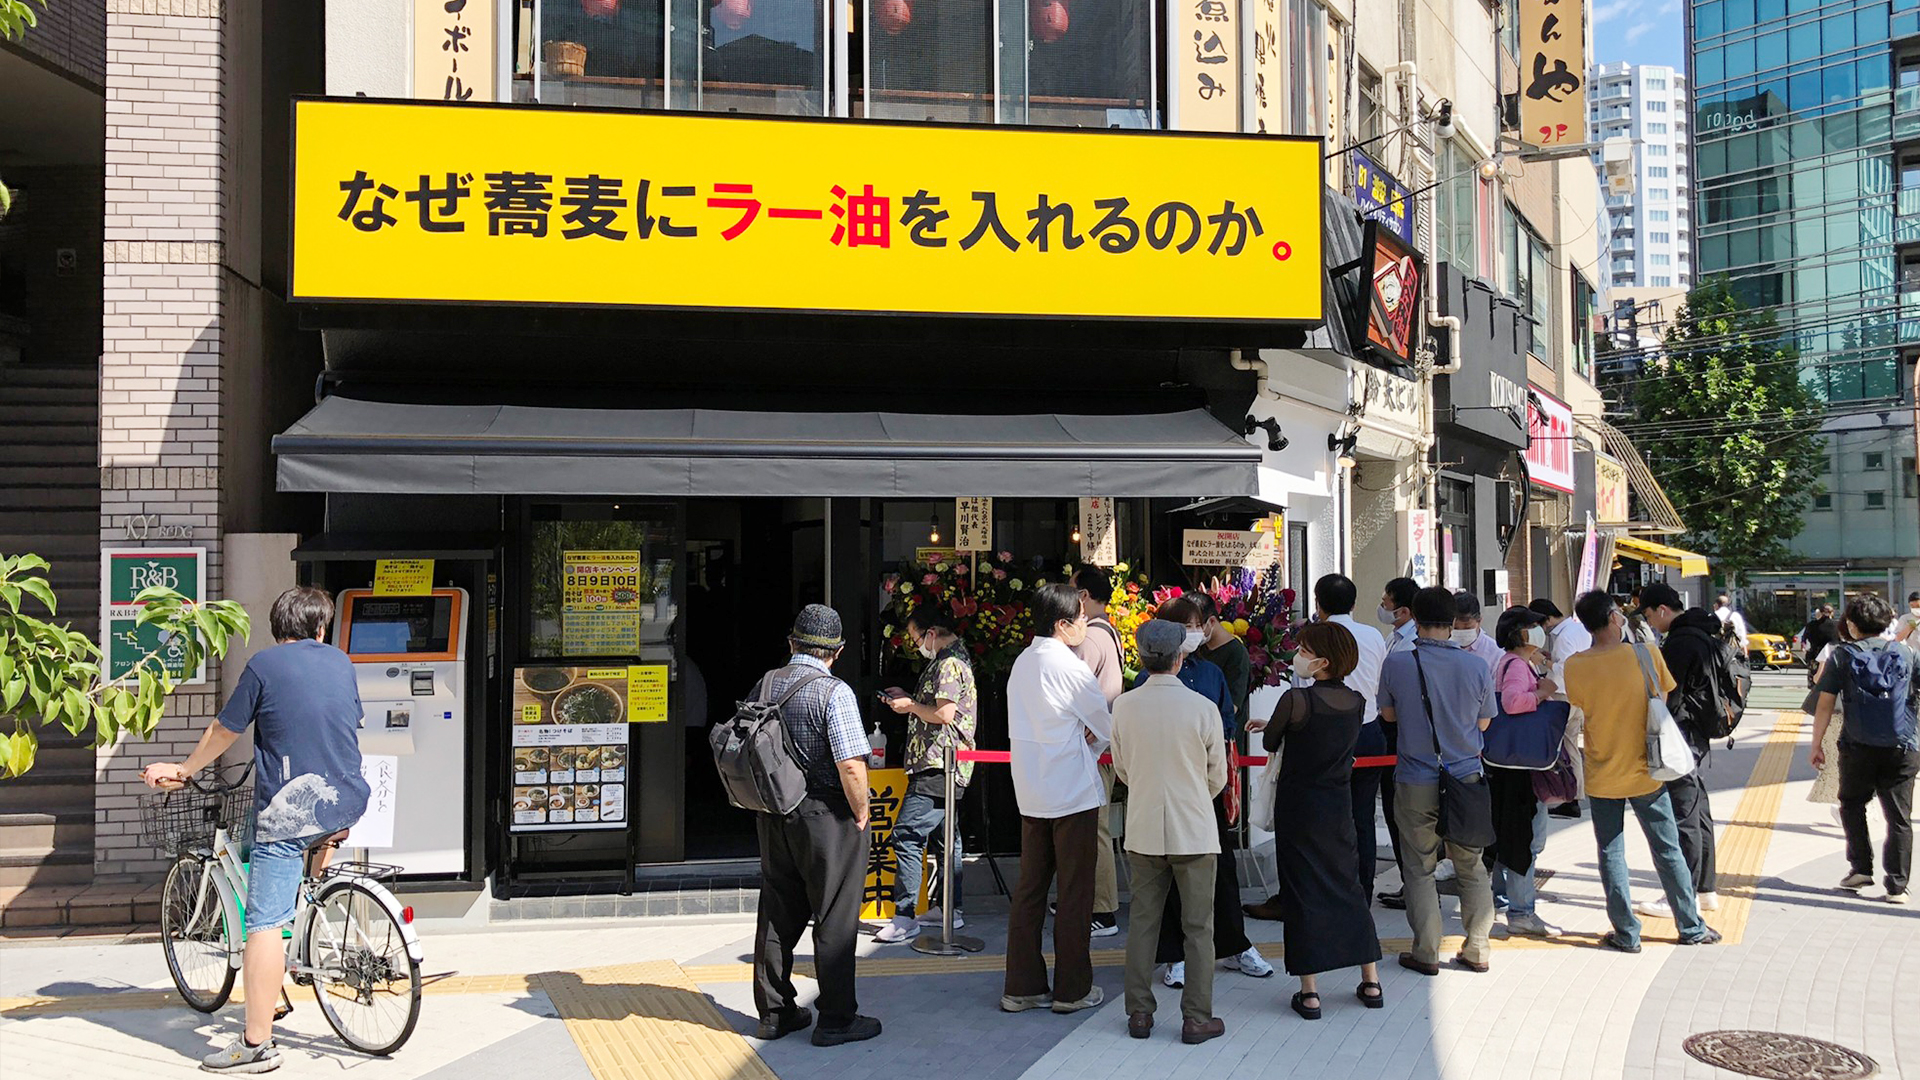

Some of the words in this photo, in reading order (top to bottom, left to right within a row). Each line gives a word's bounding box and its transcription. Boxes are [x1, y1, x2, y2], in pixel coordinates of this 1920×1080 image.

[1539, 123, 1568, 143] 2F
[337, 169, 1293, 262] なぜ蕎麦にラー油を入れるのか。
[122, 515, 156, 540] KY
[130, 567, 178, 590] R&B
[862, 785, 900, 917] 営業中
